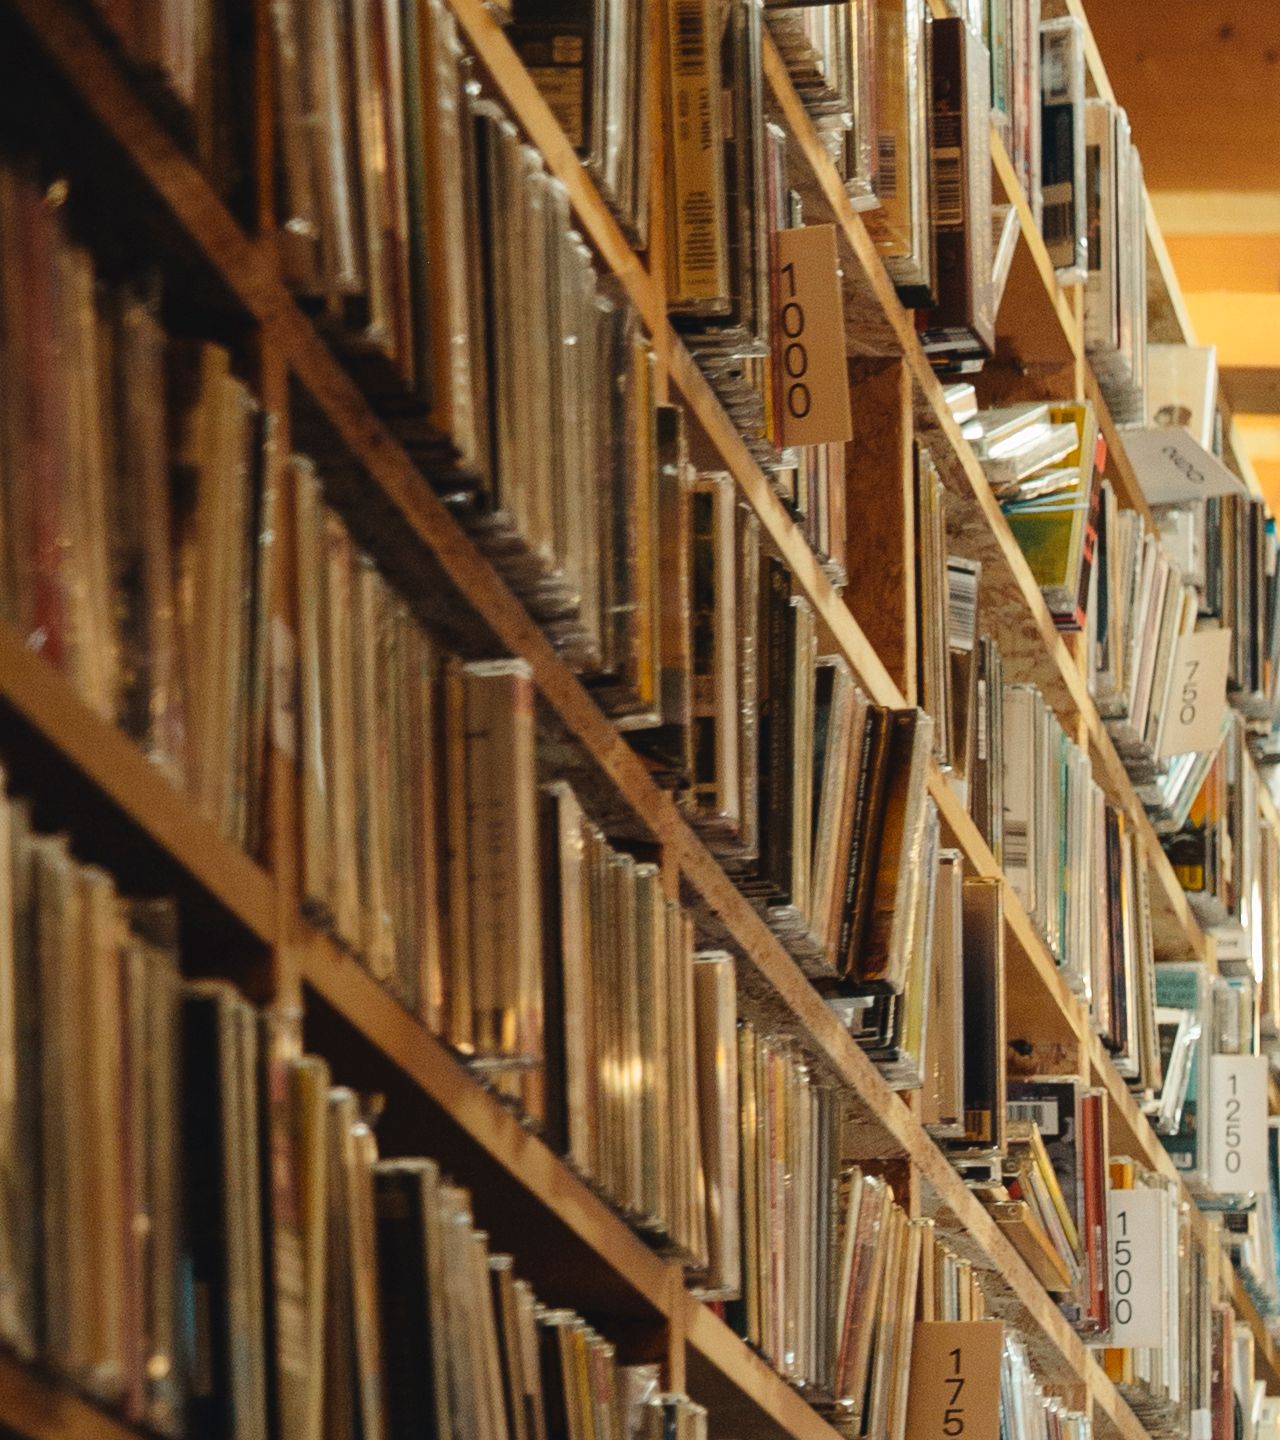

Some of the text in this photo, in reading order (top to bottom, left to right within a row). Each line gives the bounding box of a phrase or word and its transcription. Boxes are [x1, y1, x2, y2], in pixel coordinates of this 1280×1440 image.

[779, 260, 812, 421] 1000
[1178, 660, 1199, 726] 750
[1224, 1072, 1243, 1176] 1250
[1112, 1210, 1133, 1327] 1500
